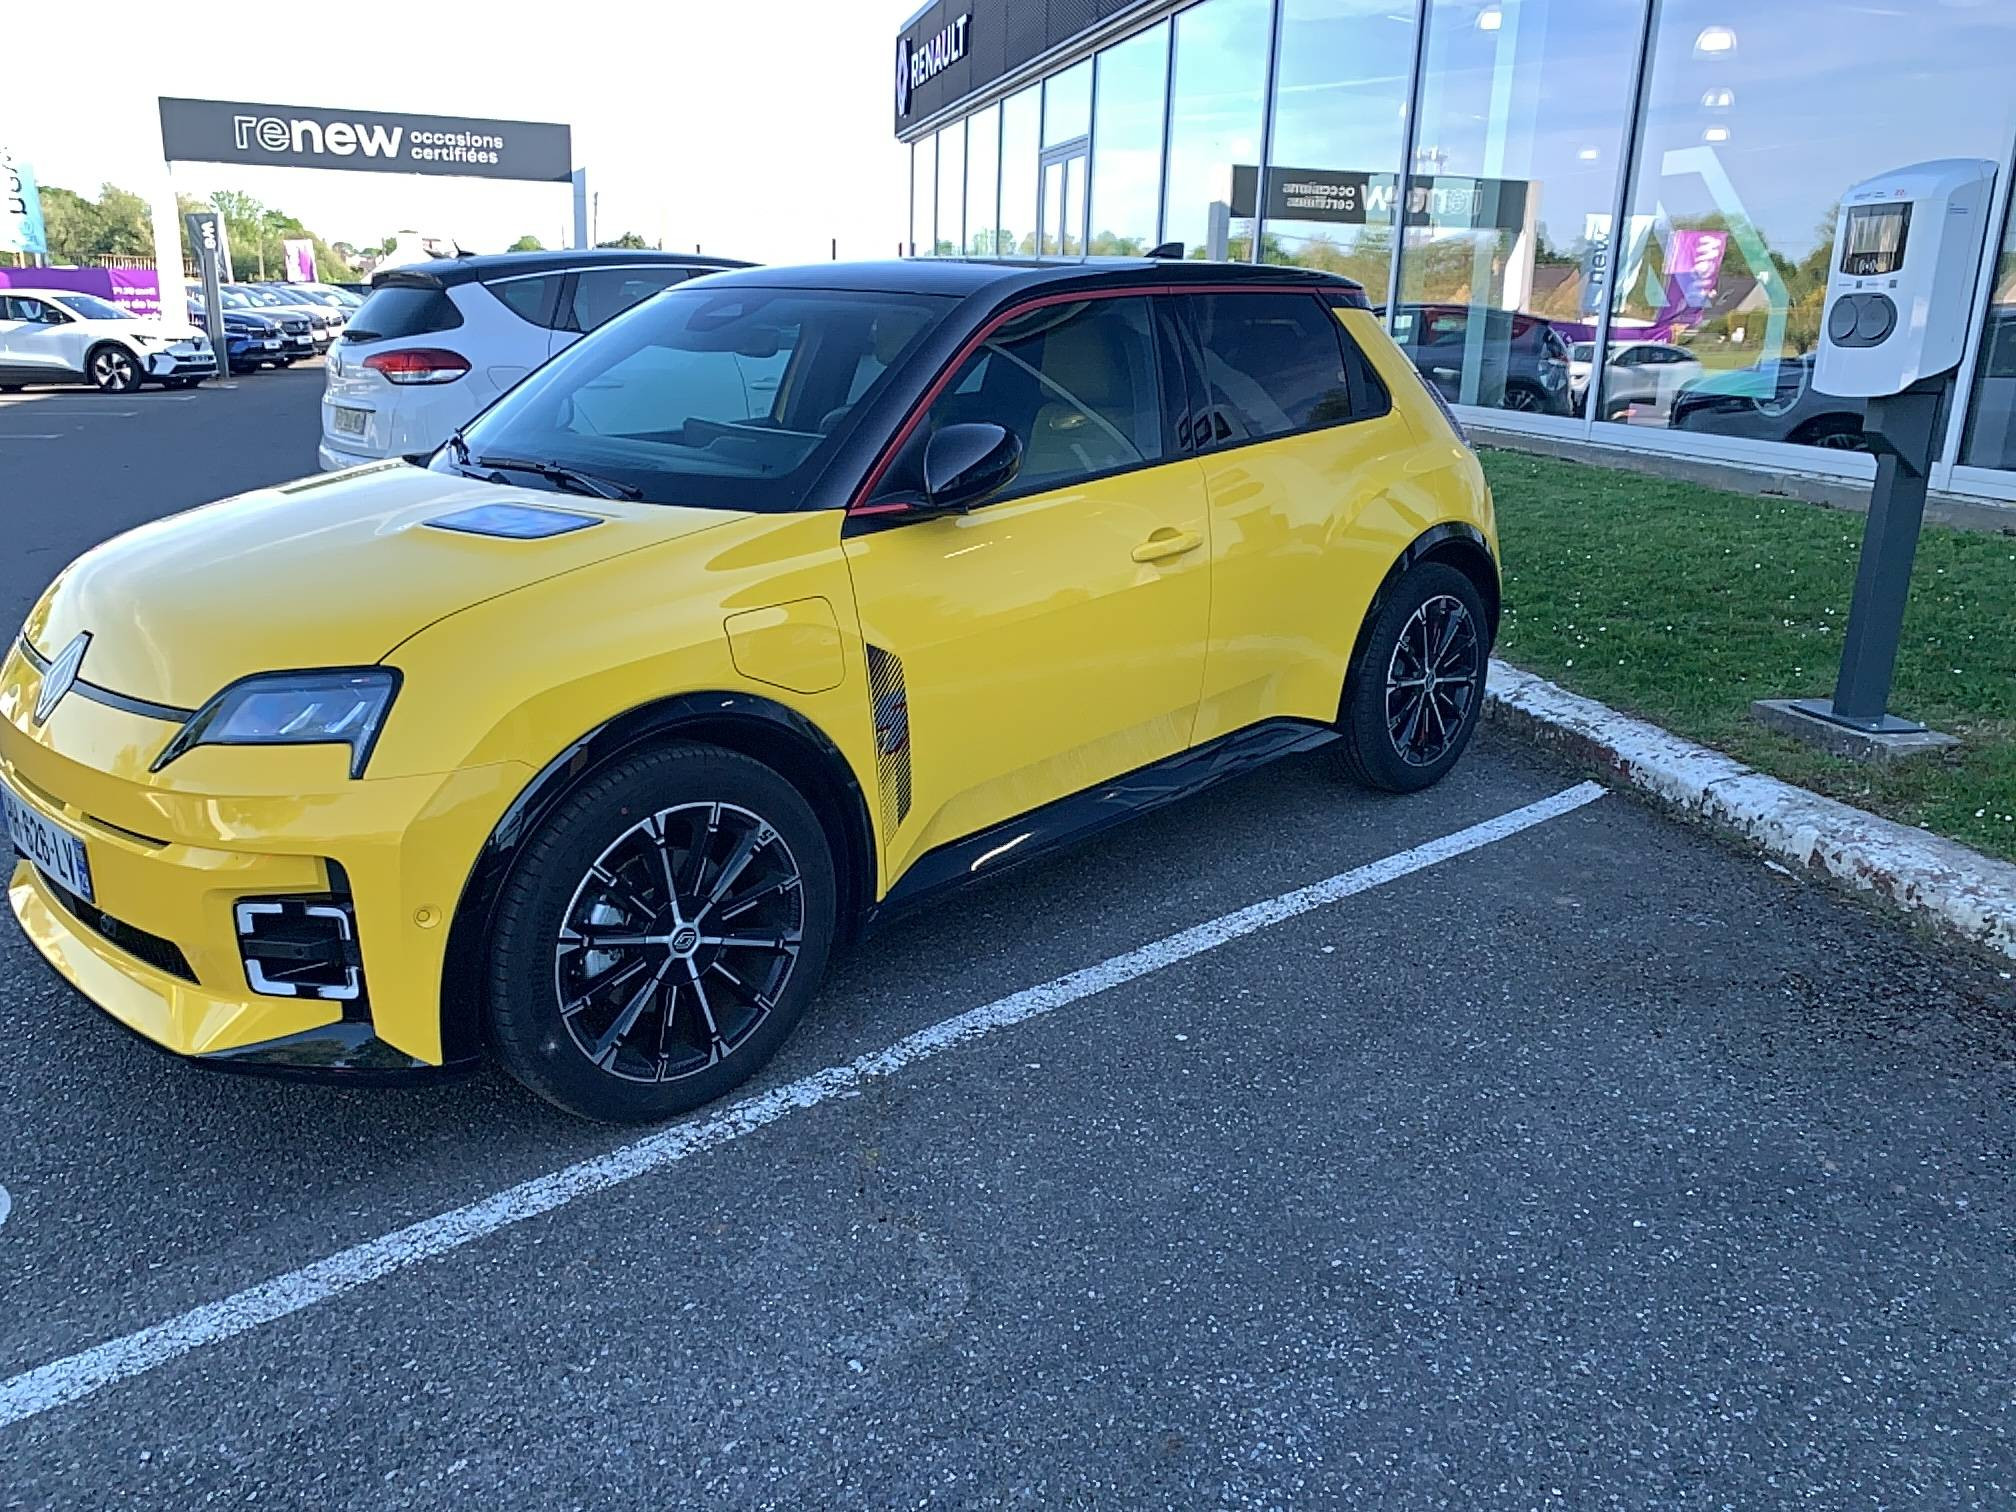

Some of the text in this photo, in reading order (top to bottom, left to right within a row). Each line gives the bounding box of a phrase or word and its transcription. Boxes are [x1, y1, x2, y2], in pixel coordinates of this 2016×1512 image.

[911, 13, 967, 90] RENAULT
[235, 116, 403, 158] renew
[410, 131, 504, 149] occasions
[411, 147, 499, 164] certifiées
